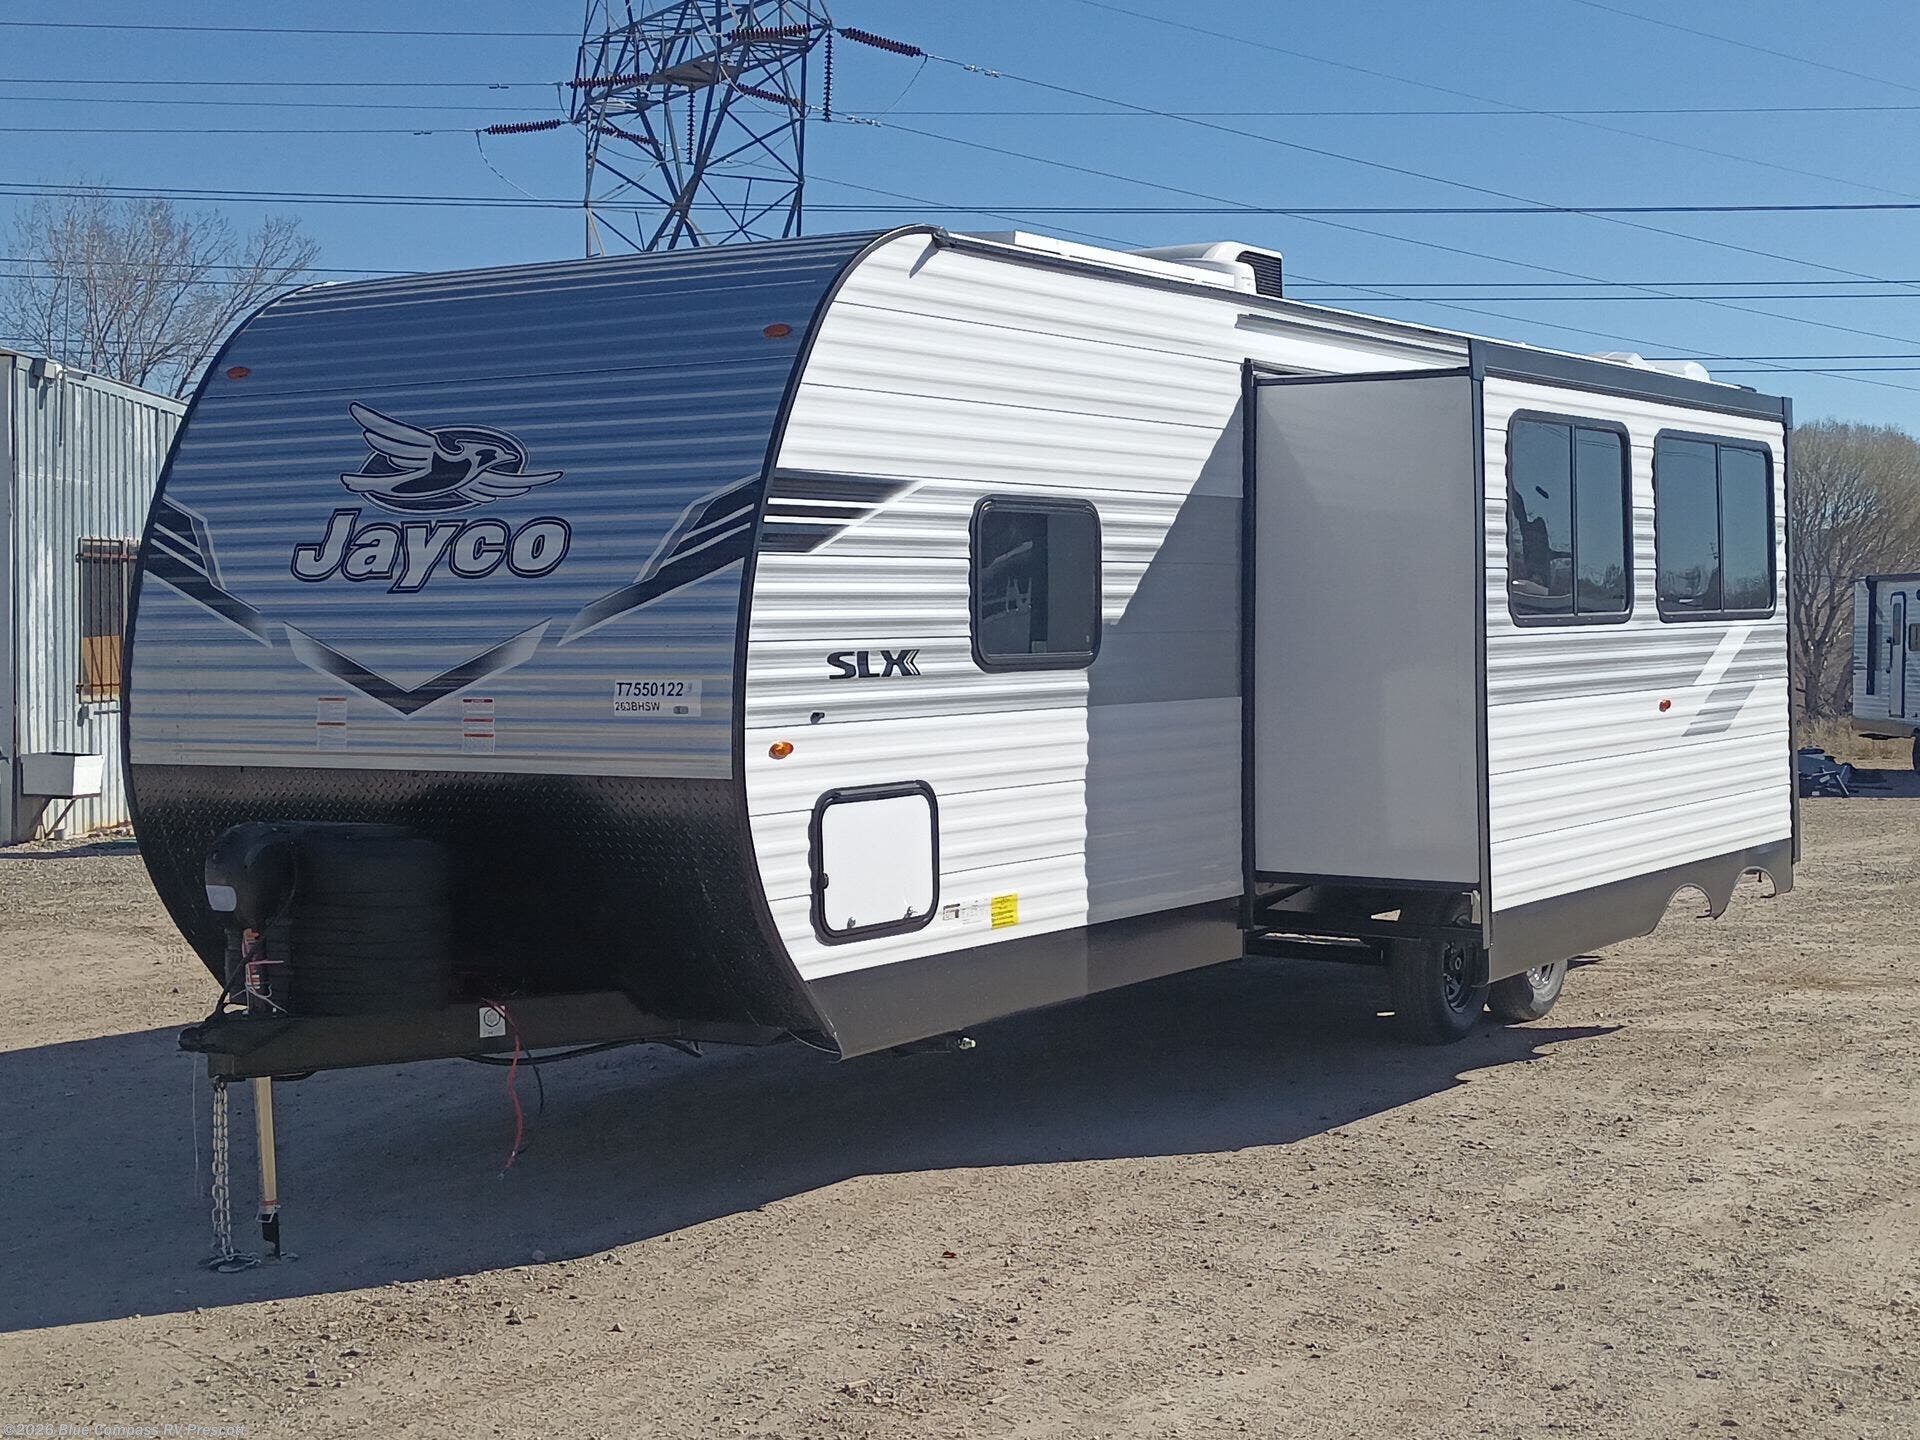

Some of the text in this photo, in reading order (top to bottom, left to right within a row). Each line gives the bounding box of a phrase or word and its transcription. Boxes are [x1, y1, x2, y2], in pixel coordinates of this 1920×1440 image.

[290, 508, 571, 593] Jayco
[826, 649, 918, 679] SLX
[616, 682, 684, 697] T7550122
